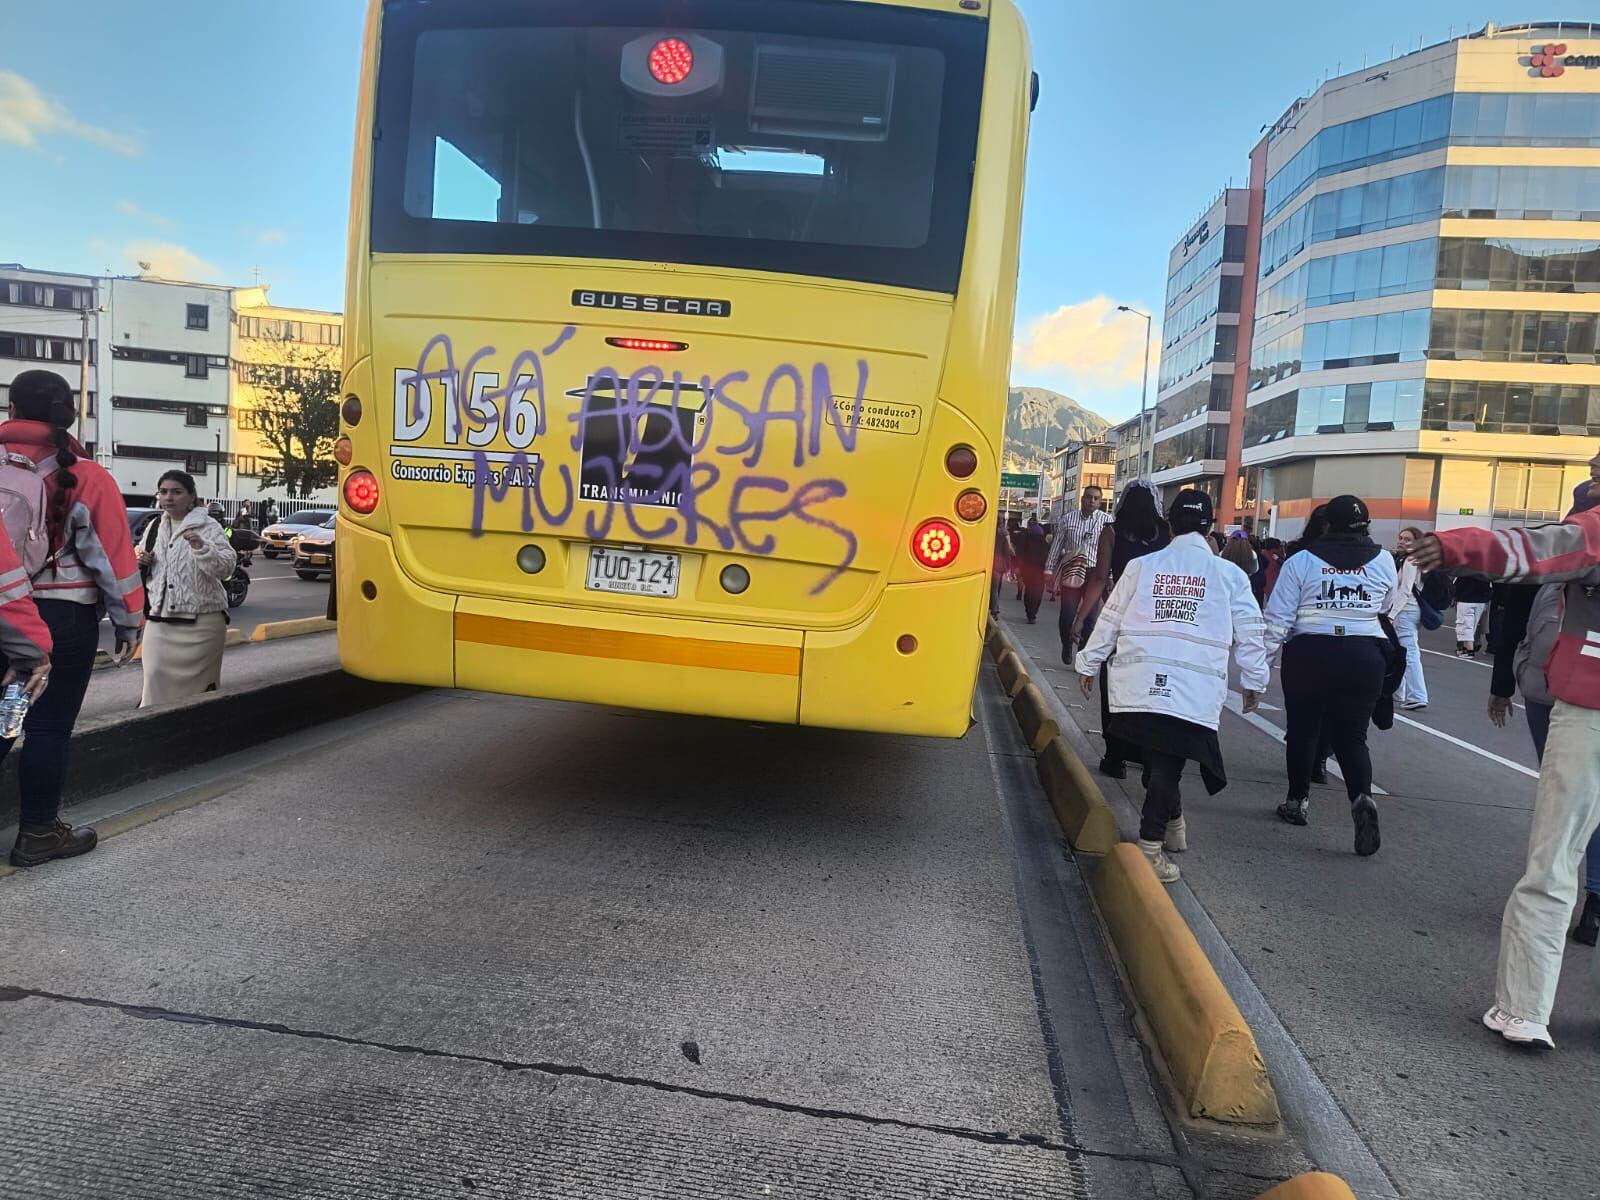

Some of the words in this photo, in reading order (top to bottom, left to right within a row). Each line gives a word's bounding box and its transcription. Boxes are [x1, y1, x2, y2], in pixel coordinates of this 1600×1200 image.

[580, 292, 722, 315] BUSSCAR
[393, 367, 538, 449] D156
[567, 359, 868, 468] ABUSAN
[867, 406, 916, 419] conduzco?
[866, 417, 900, 430] 4824304
[391, 459, 452, 482] Consorcio
[454, 463, 501, 489] Exps
[471, 451, 858, 597] MUJERES
[1154, 573, 1206, 587] SECRETARÍA
[1153, 585, 1164, 595] DE
[1165, 585, 1205, 599] GOBIERNO
[1155, 599, 1198, 612] DERECHOS
[1155, 609, 1196, 621] HUMANOS
